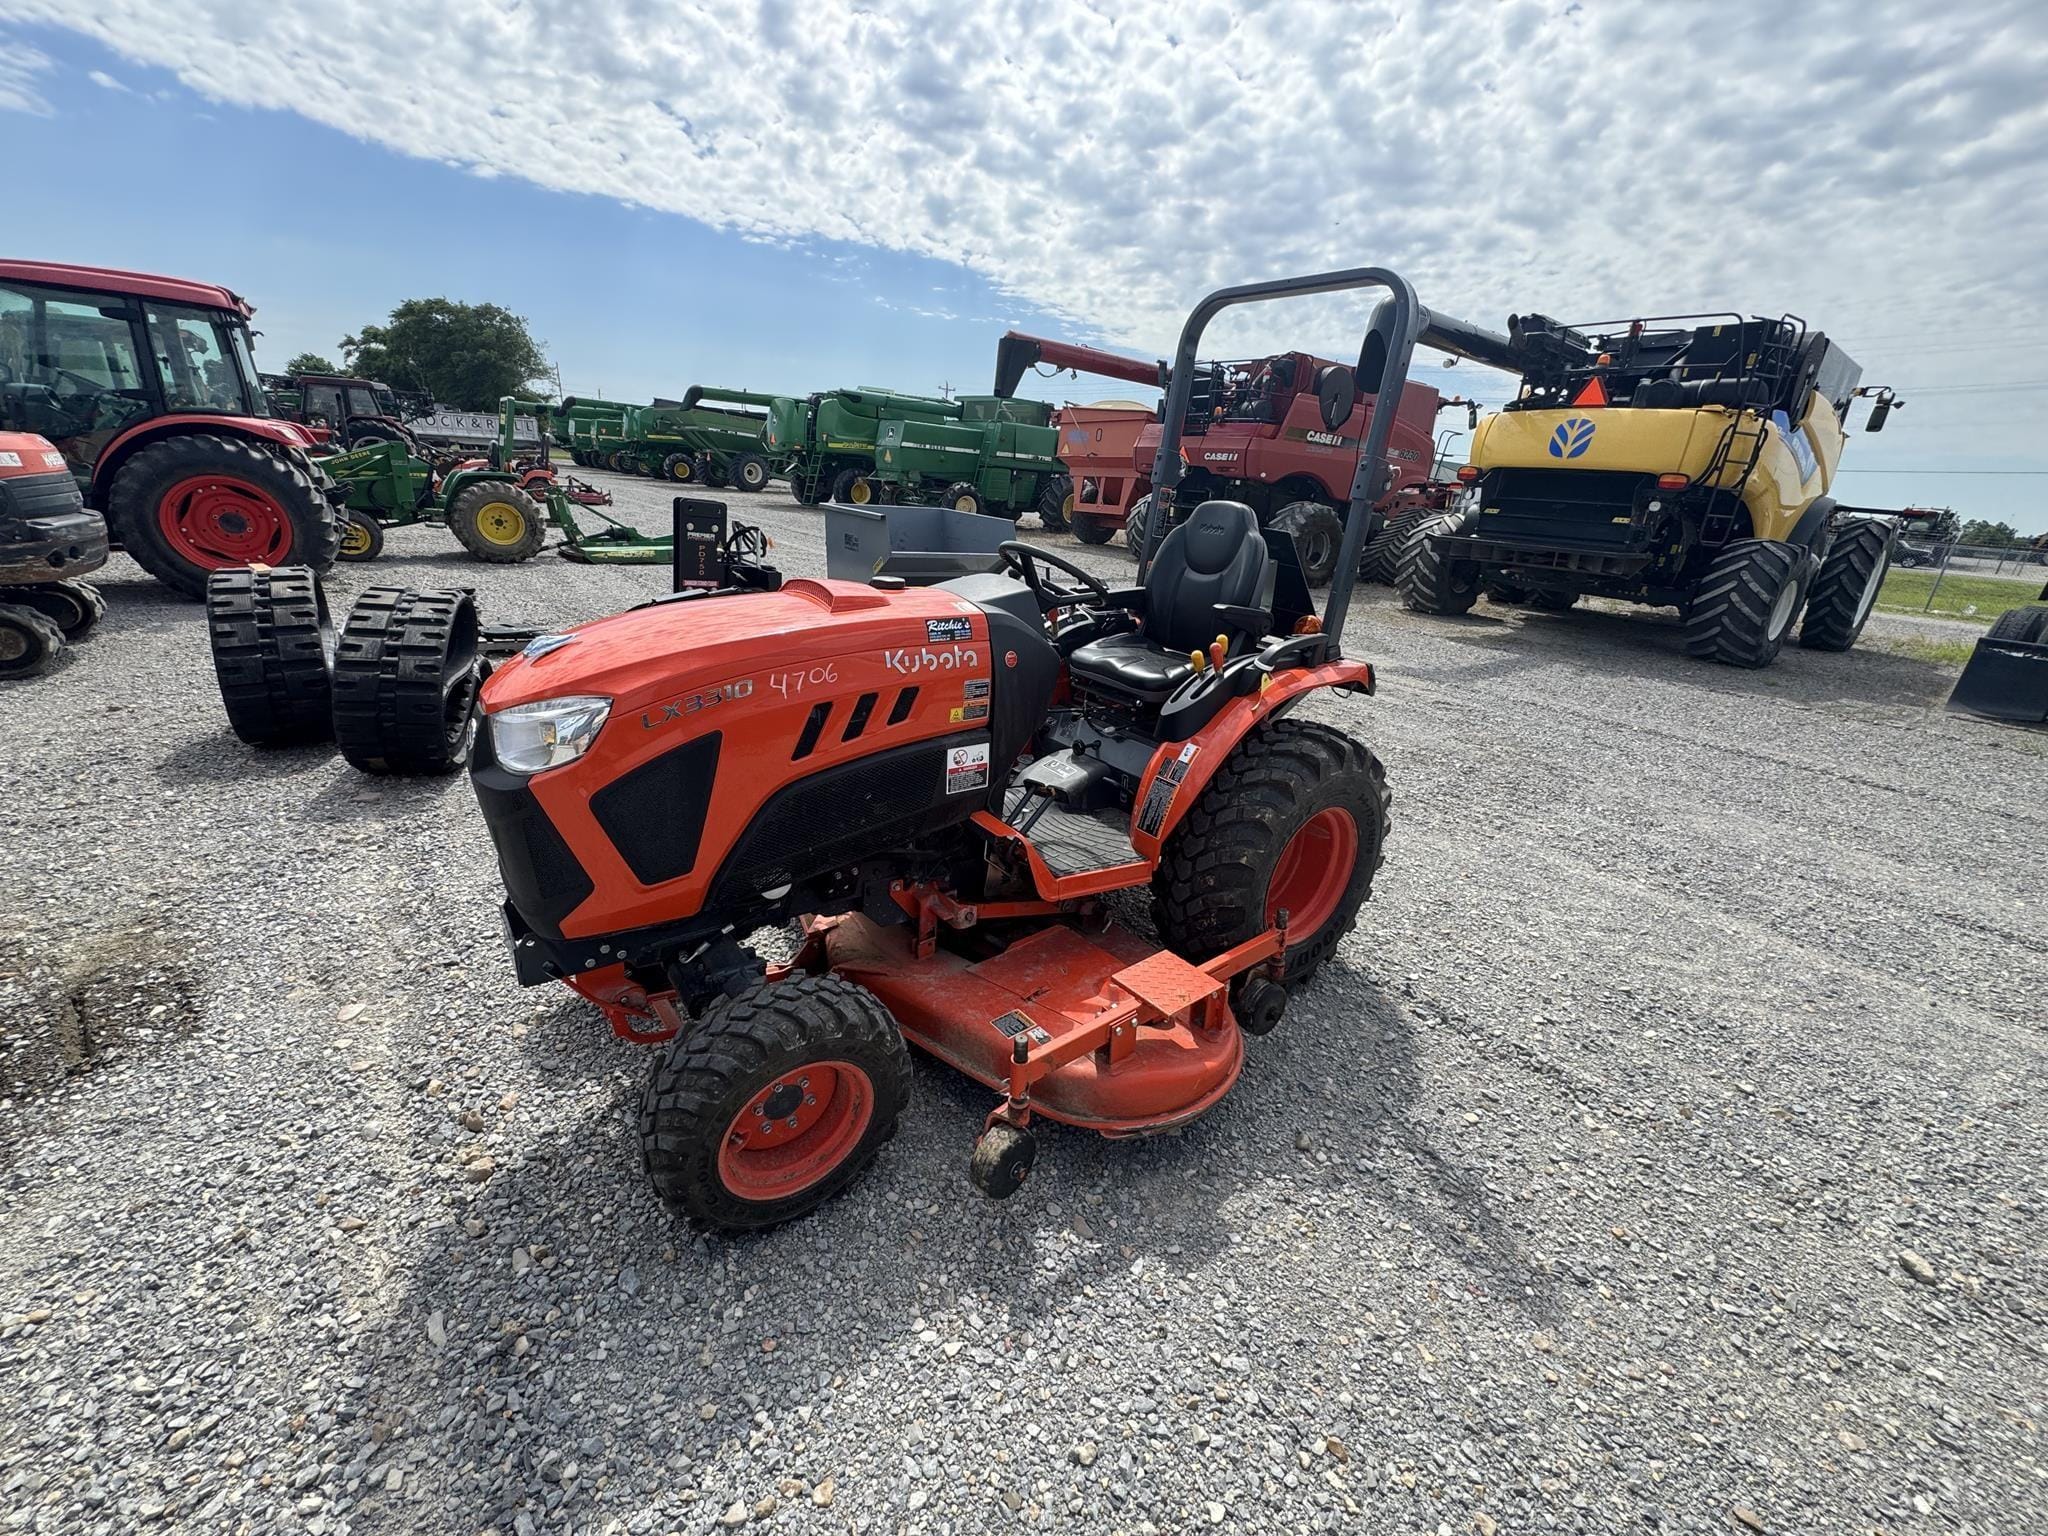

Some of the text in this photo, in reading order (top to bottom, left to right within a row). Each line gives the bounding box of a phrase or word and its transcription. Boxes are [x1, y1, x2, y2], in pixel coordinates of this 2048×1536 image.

[1306, 430, 1333, 444] CASE
[1204, 452, 1228, 461] CASE
[926, 617, 971, 632] Ritchie's
[884, 644, 978, 675] Kubota
[769, 662, 838, 700] 4706
[641, 679, 753, 729] LX3310
